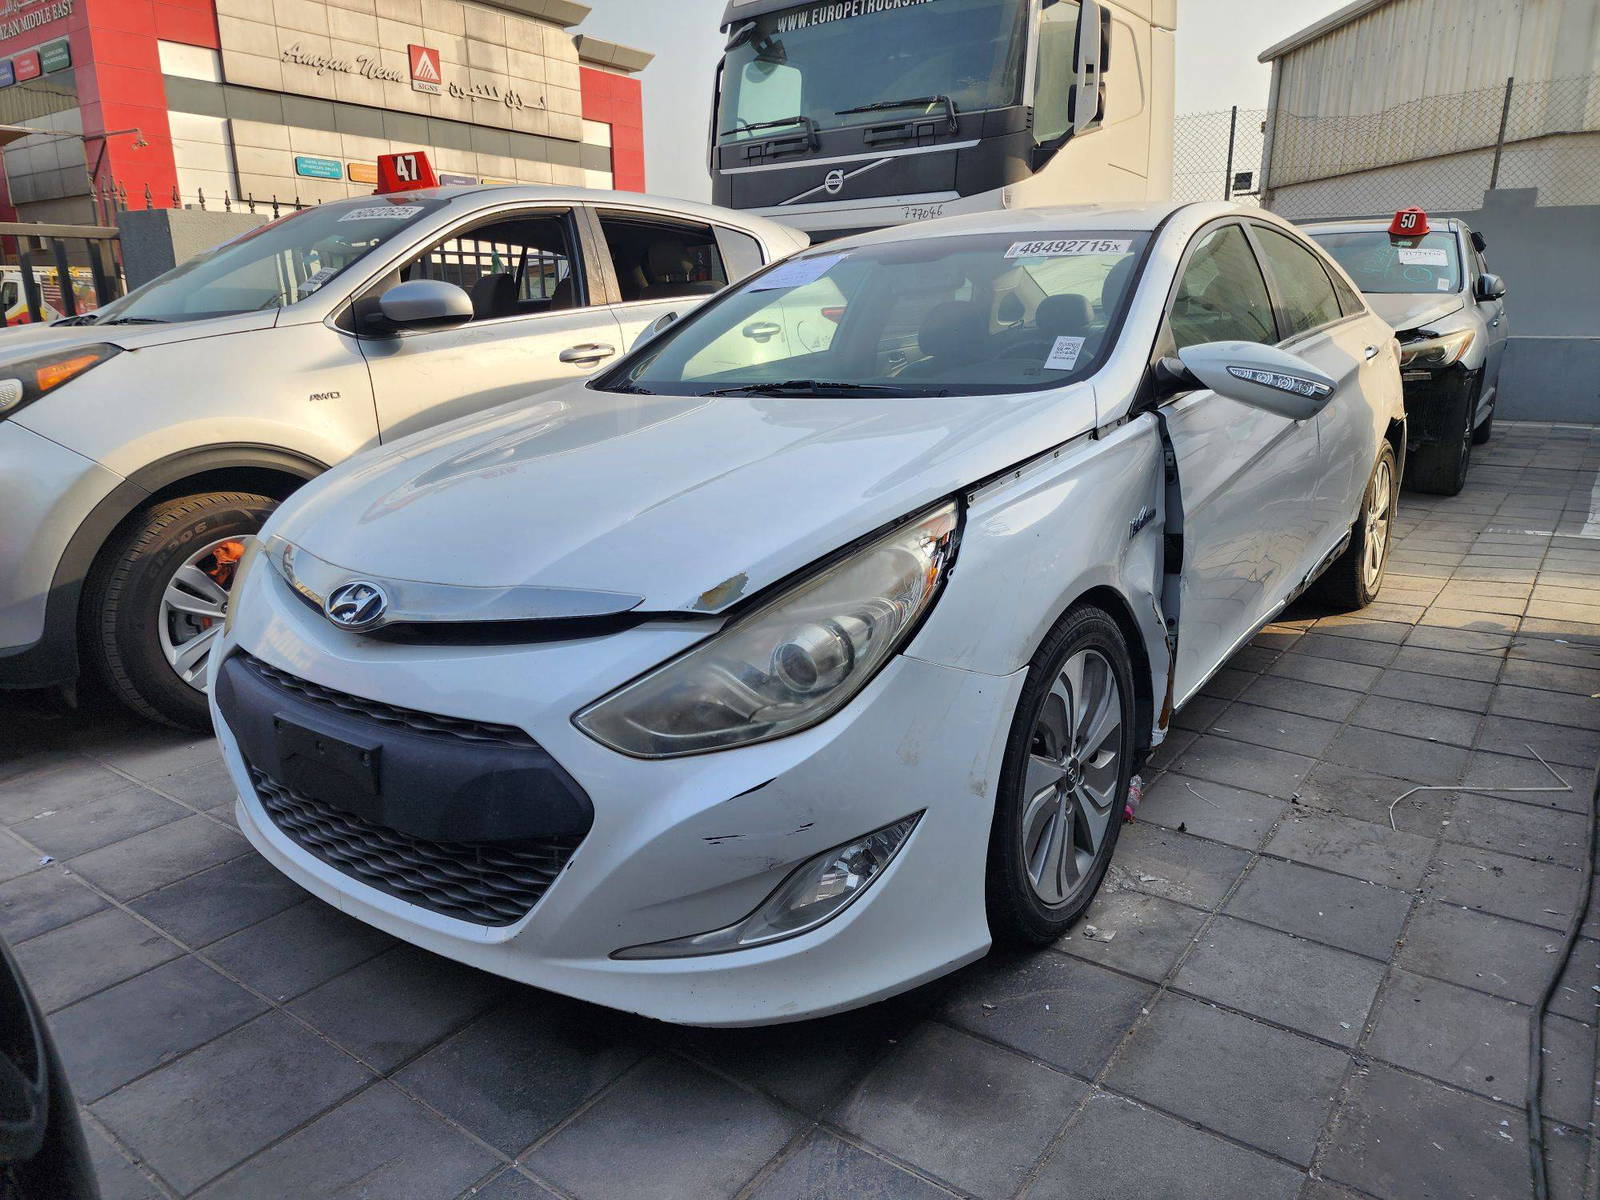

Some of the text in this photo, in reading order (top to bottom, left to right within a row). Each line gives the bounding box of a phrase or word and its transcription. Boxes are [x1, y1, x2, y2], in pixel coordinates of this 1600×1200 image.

[20, 7, 51, 32] MIDDLE
[52, 0, 73, 19] EAST
[777, 0, 934, 33] WWW.EUROPETRUCK.
[356, 55, 403, 82] Neon
[417, 82, 438, 92] SIGNS
[396, 154, 418, 181] 47
[1400, 213, 1417, 229] 50
[309, 391, 341, 402] AWD
